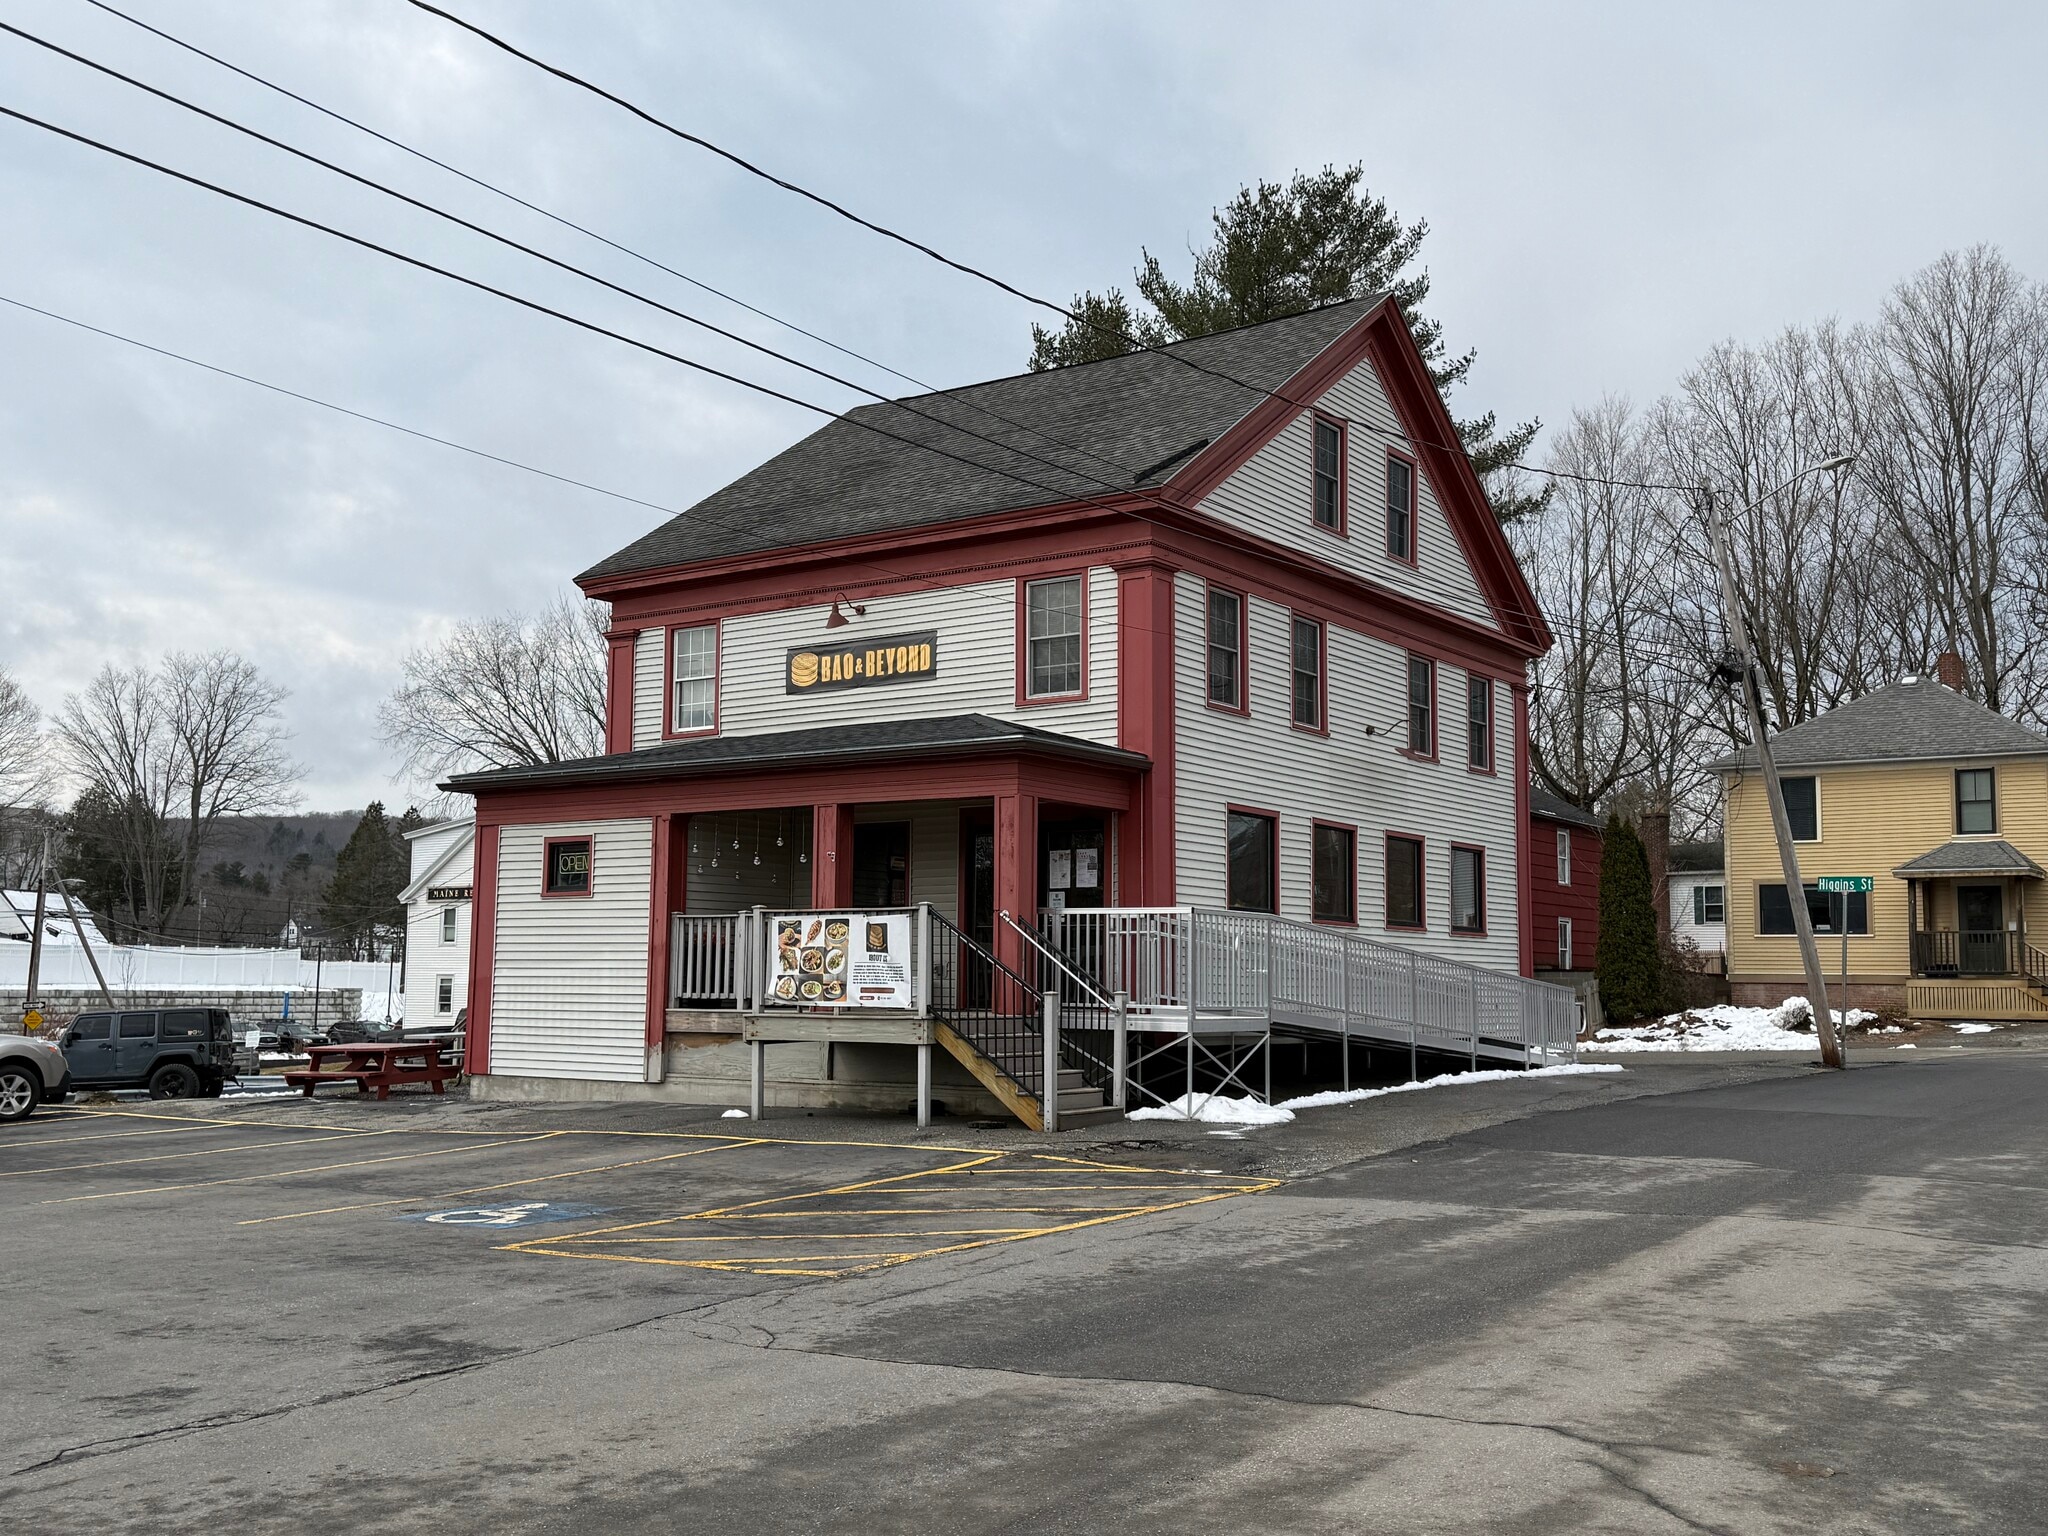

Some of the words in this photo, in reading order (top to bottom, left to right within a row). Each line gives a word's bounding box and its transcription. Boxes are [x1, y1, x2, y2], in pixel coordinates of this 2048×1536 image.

[821, 652, 854, 682] BAO
[855, 657, 863, 674] &
[865, 643, 931, 677] BEYOND
[561, 855, 589, 871] OPEN
[1819, 878, 1855, 892] Higgins
[1861, 878, 1872, 890] St
[433, 889, 459, 898] MAINE
